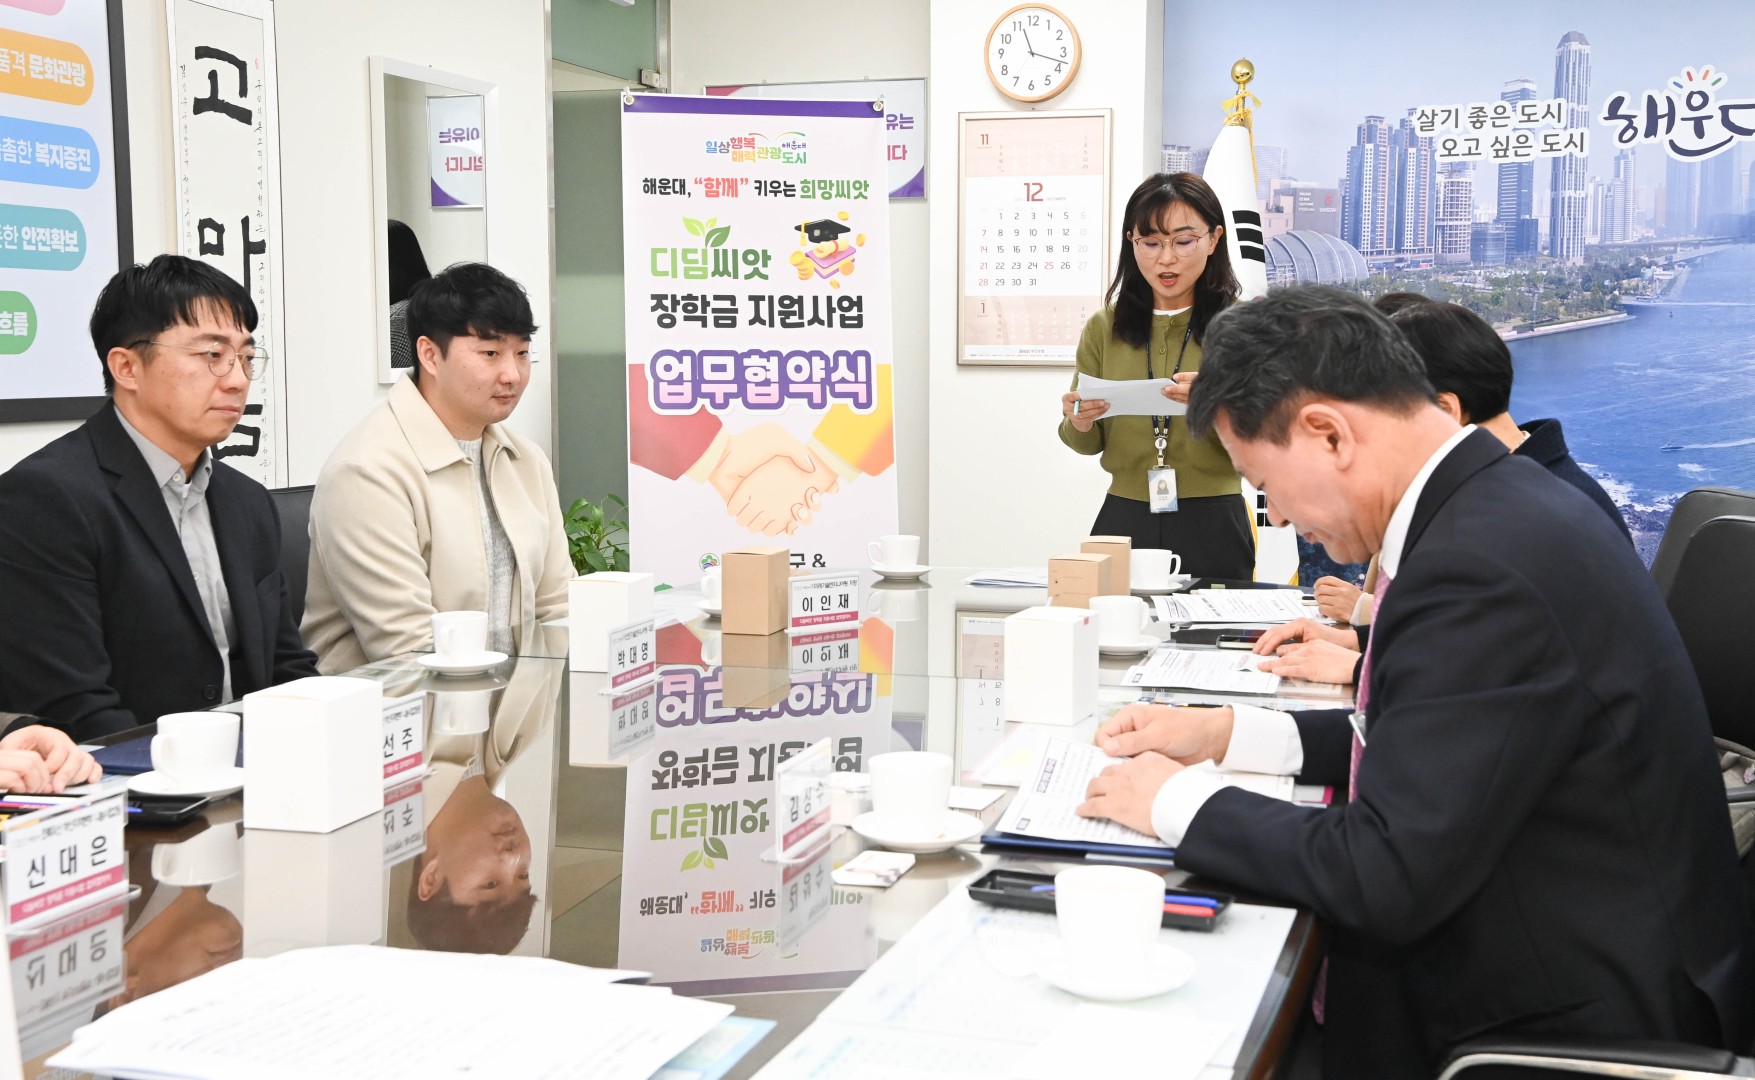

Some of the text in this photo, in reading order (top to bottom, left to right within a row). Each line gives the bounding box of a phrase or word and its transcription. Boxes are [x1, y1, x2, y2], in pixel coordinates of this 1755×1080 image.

[1012, 21, 1022, 31] 11
[1027, 15, 1040, 26] 12
[1046, 20, 1051, 30] 1
[1000, 34, 1012, 44] 10
[1056, 29, 1063, 41] 2
[998, 48, 1005, 59] 9
[1060, 47, 1067, 58] 3
[29, 53, 87, 88] 문화관광
[1001, 64, 1008, 76] 8
[1054, 63, 1062, 74] 4
[1013, 76, 1020, 87] 7
[1028, 80, 1035, 91] 6
[1044, 75, 1052, 86] 5
[1416, 103, 1563, 132] 살기 좋은 도시
[980, 133, 989, 145] 11
[1439, 132, 1585, 159] 오고 싶은 도시
[0, 136, 92, 173] 촘한 복지증진
[642, 177, 691, 198] 해운대,
[754, 179, 797, 198] 키우는
[799, 179, 870, 200] 희망씨앗
[1023, 182, 1044, 202] 12
[999, 212, 1003, 220] 1
[1014, 212, 1020, 220] 2
[1031, 212, 1036, 220] 3
[1047, 211, 1053, 220] 4
[1063, 211, 1069, 220] 5
[0, 223, 80, 253] 한 안전확보
[981, 229, 987, 237] 7
[997, 229, 1004, 237] 8
[1014, 229, 1020, 237] 9
[1029, 228, 1038, 237] 10
[1047, 228, 1053, 236] 11
[1062, 228, 1070, 236] 12
[980, 245, 988, 253] 14
[996, 245, 1005, 254] 15
[1013, 245, 1021, 254] 16
[1029, 245, 1037, 253] 17
[1045, 244, 1054, 253] 18
[1062, 244, 1070, 253] 19
[650, 247, 772, 281] 디딤씨앗
[980, 262, 988, 270] 21
[995, 262, 1005, 270] 22
[1011, 261, 1021, 270] 23
[1027, 261, 1038, 270] 24
[1044, 261, 1054, 270] 25
[1060, 261, 1071, 270] 26
[978, 278, 1037, 287] 28 29 30 31
[650, 293, 864, 330] 장학금 지원사업
[980, 302, 985, 314] 1
[651, 350, 871, 411] 업무협약식
[812, 553, 826, 567] &
[27, 835, 108, 890] 신대은
